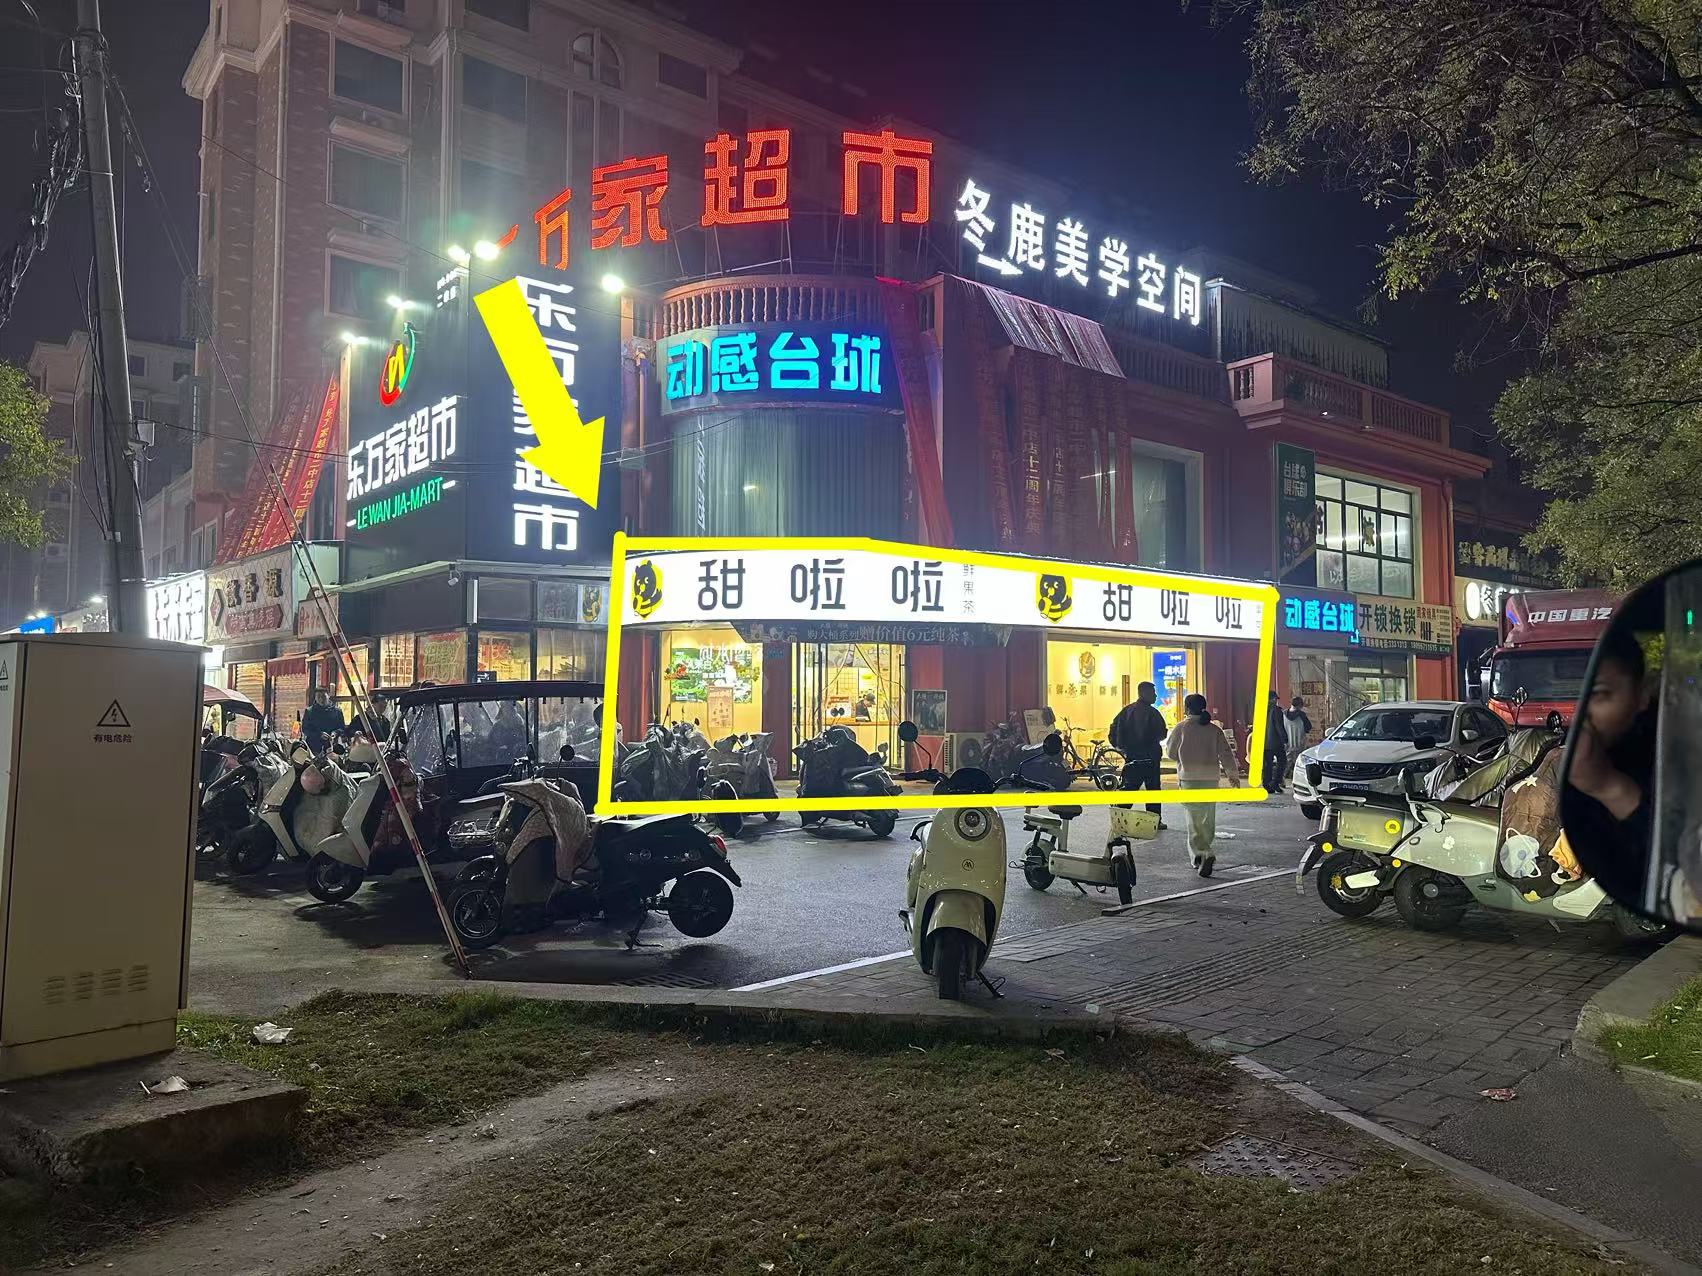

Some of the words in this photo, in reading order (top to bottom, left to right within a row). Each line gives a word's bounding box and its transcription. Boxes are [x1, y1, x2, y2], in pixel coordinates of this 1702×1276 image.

[497, 128, 933, 271] 万家超市
[955, 178, 1201, 326] 冬鹿美学空间
[665, 331, 882, 400] 动感台球
[346, 395, 458, 501] 乐万家超市
[368, 497, 391, 527] WAN
[697, 558, 945, 613] 甜啦啦
[1285, 598, 1355, 633] 动感台球
[1359, 603, 1417, 635] 开锁换锁
[1528, 607, 1612, 623] 中国重汽
[94, 734, 132, 743] 有电危险
